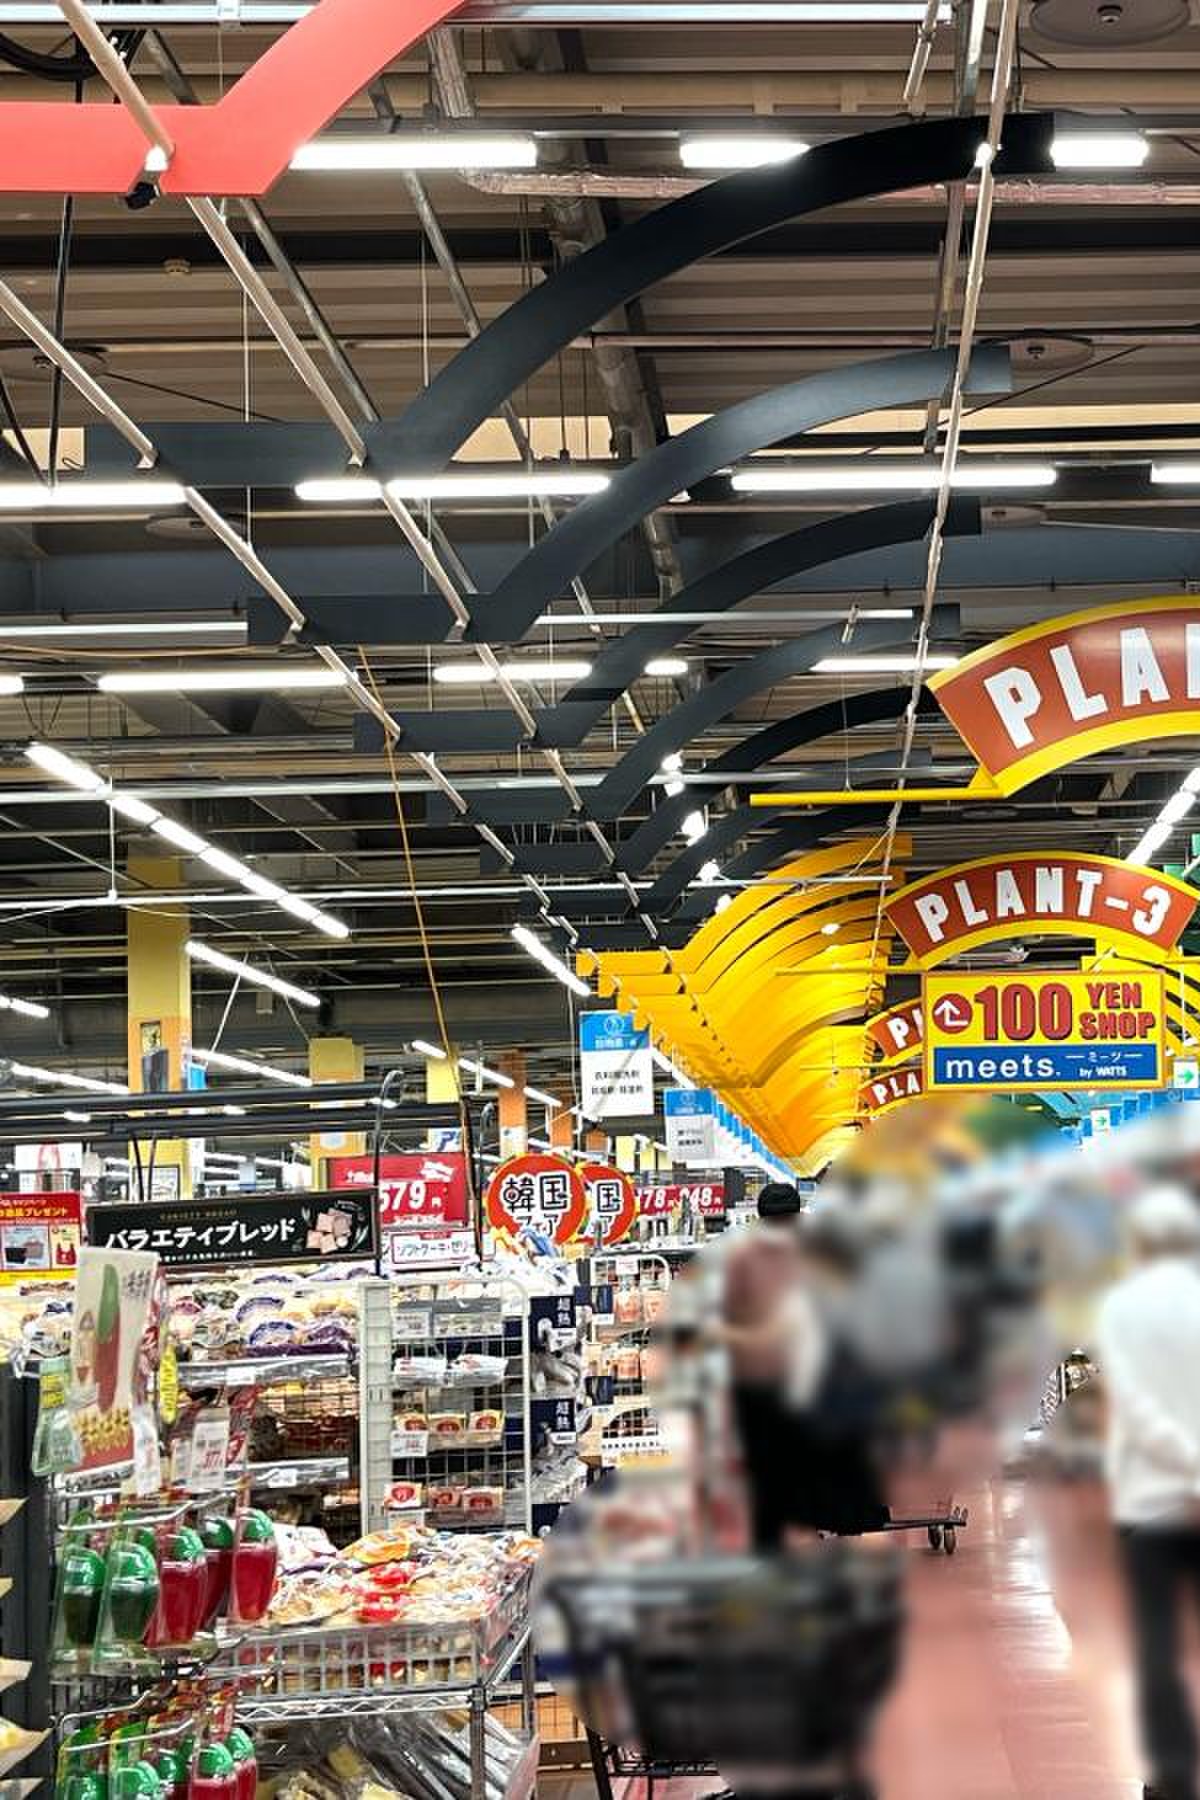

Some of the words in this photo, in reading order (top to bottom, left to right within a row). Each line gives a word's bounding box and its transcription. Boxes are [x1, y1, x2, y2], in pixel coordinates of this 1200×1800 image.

[915, 867, 1172, 943] PLANT-3
[974, 982, 1074, 1041] 100
[1085, 982, 1143, 1010] YEN
[1079, 1011, 1157, 1041] SHOP
[502, 1174, 568, 1214] 韓国
[596, 1181, 621, 1213] 国
[105, 1218, 296, 1251] バラエティブレッド
